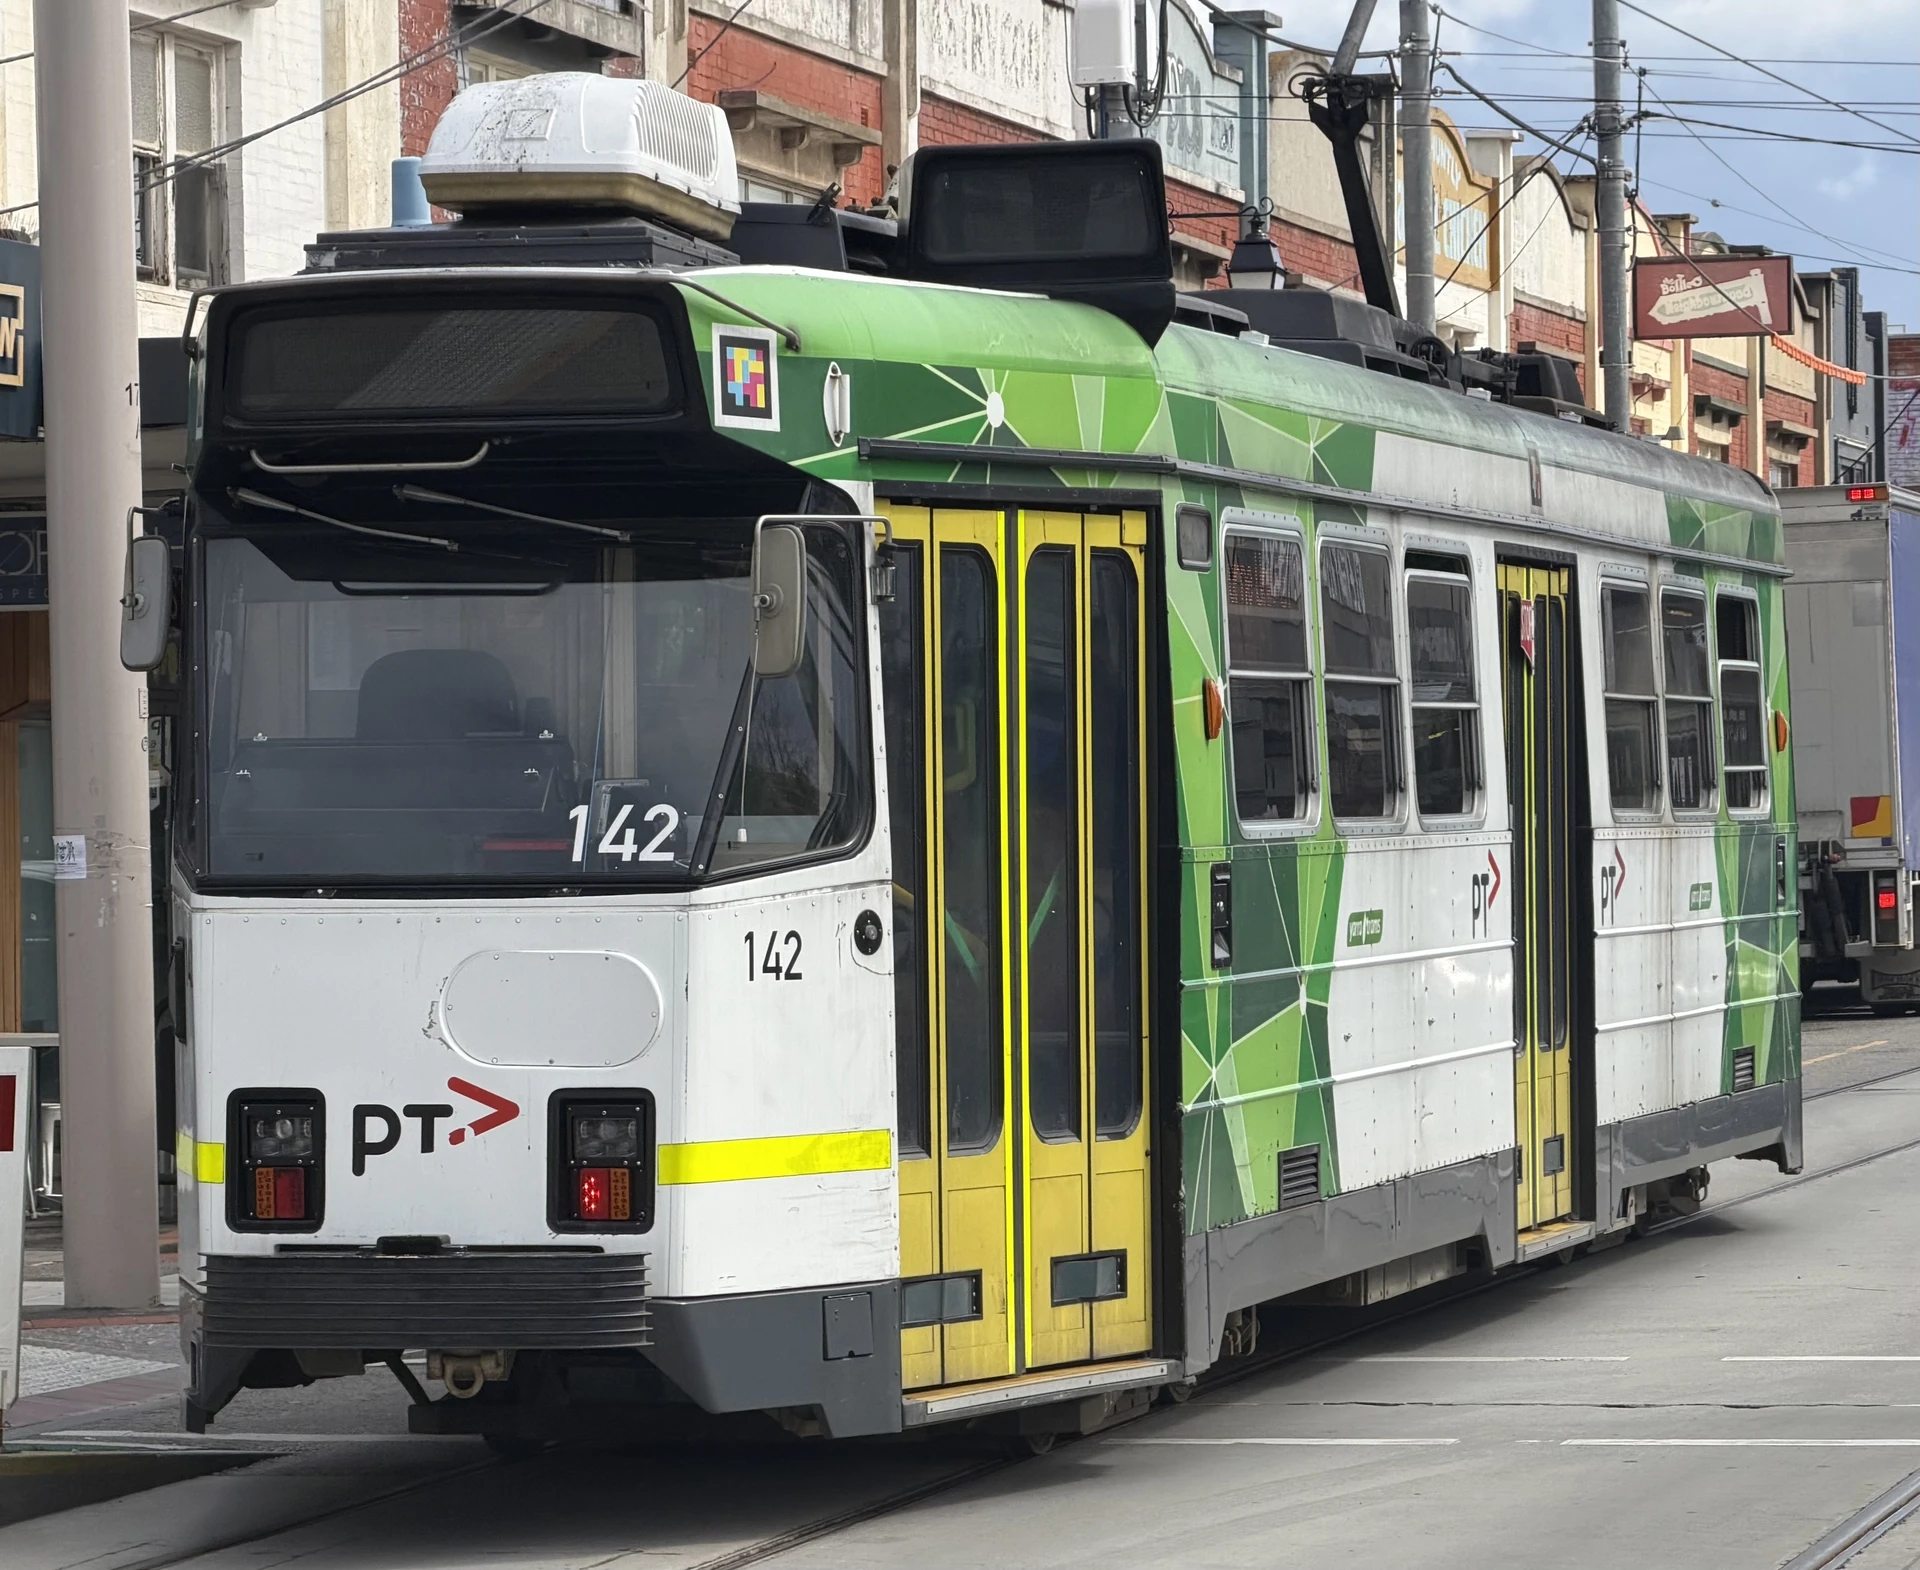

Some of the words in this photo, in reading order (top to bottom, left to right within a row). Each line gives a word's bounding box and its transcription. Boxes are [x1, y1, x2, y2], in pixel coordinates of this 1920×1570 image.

[569, 803, 680, 862] 142
[1472, 873, 1490, 940] PT
[1601, 865, 1616, 926] PT
[744, 930, 803, 982] 142
[352, 1103, 454, 1177] PT
